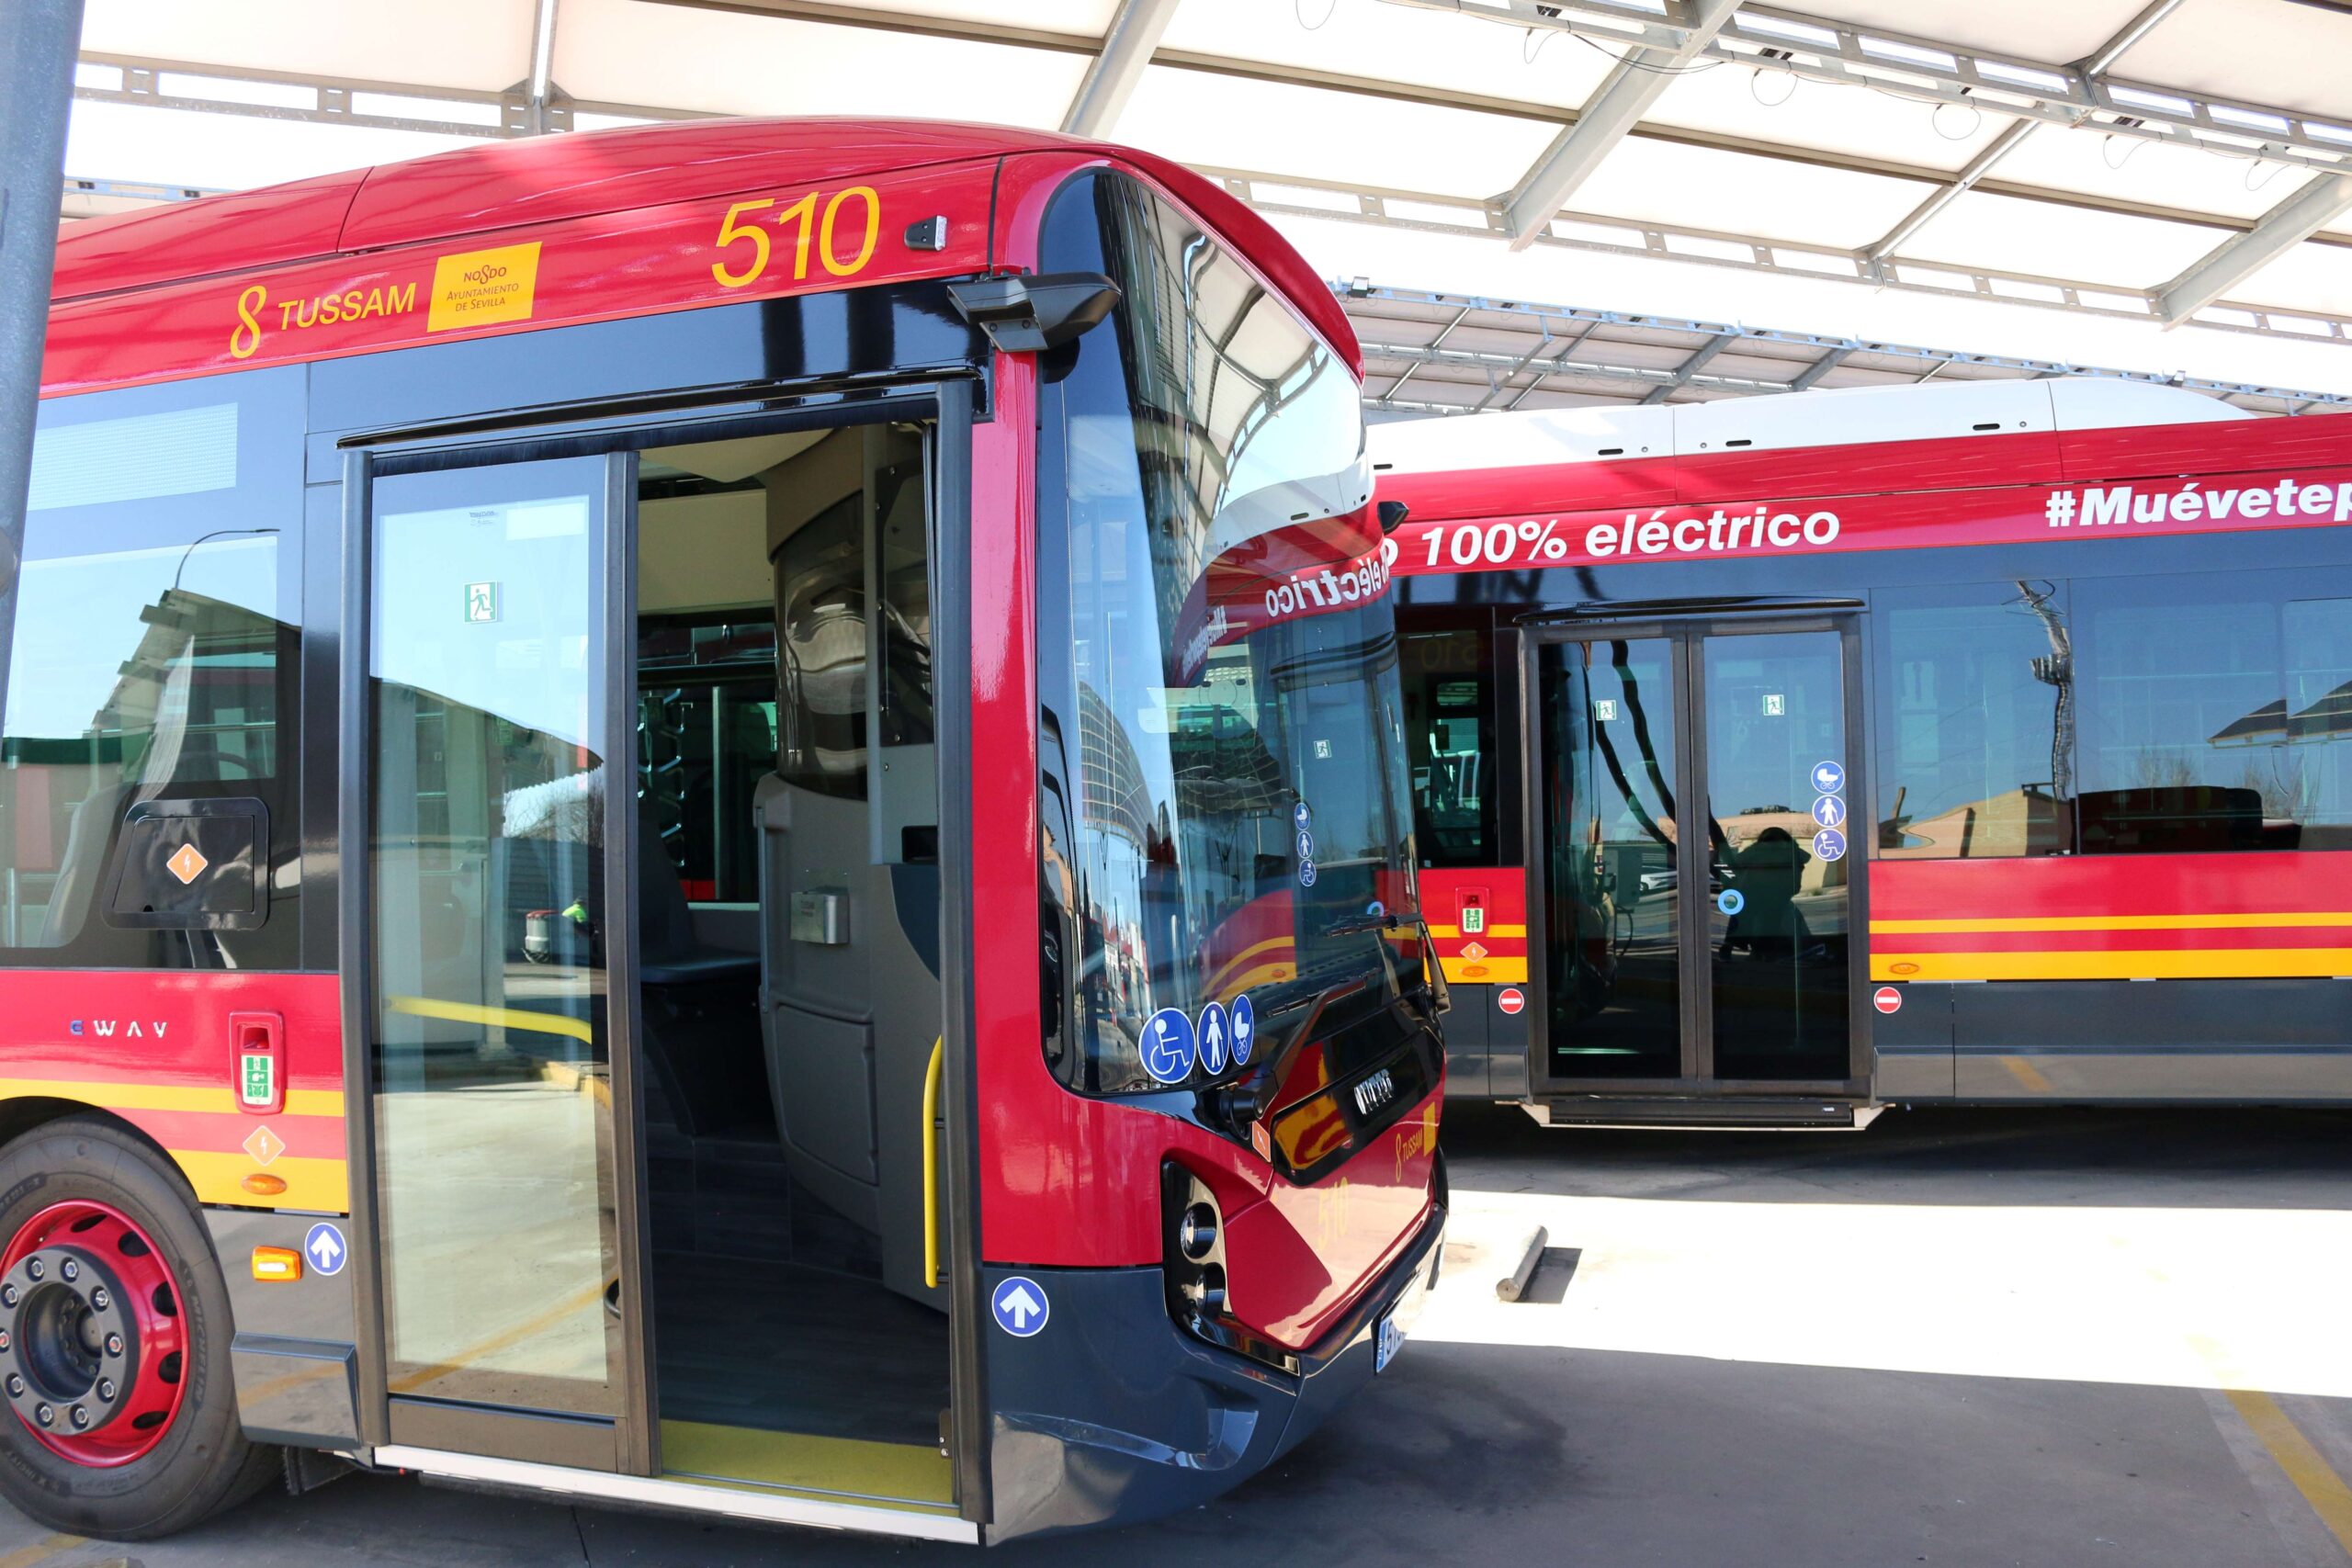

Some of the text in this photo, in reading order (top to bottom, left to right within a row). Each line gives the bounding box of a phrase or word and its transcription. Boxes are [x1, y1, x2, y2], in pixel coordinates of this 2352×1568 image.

[711, 186, 880, 288] 510
[278, 282, 417, 331] TUSSAM
[446, 283, 519, 301] AYUNTAMIENTO
[455, 297, 505, 311] DE SEVILLA
[1421, 519, 1567, 567] 100%
[1585, 507, 1840, 557] eléctrico
[70, 1020, 167, 1039] EWAY
[1402, 1128, 1423, 1162] TUSSAM
[1317, 1177, 1349, 1250] 510
